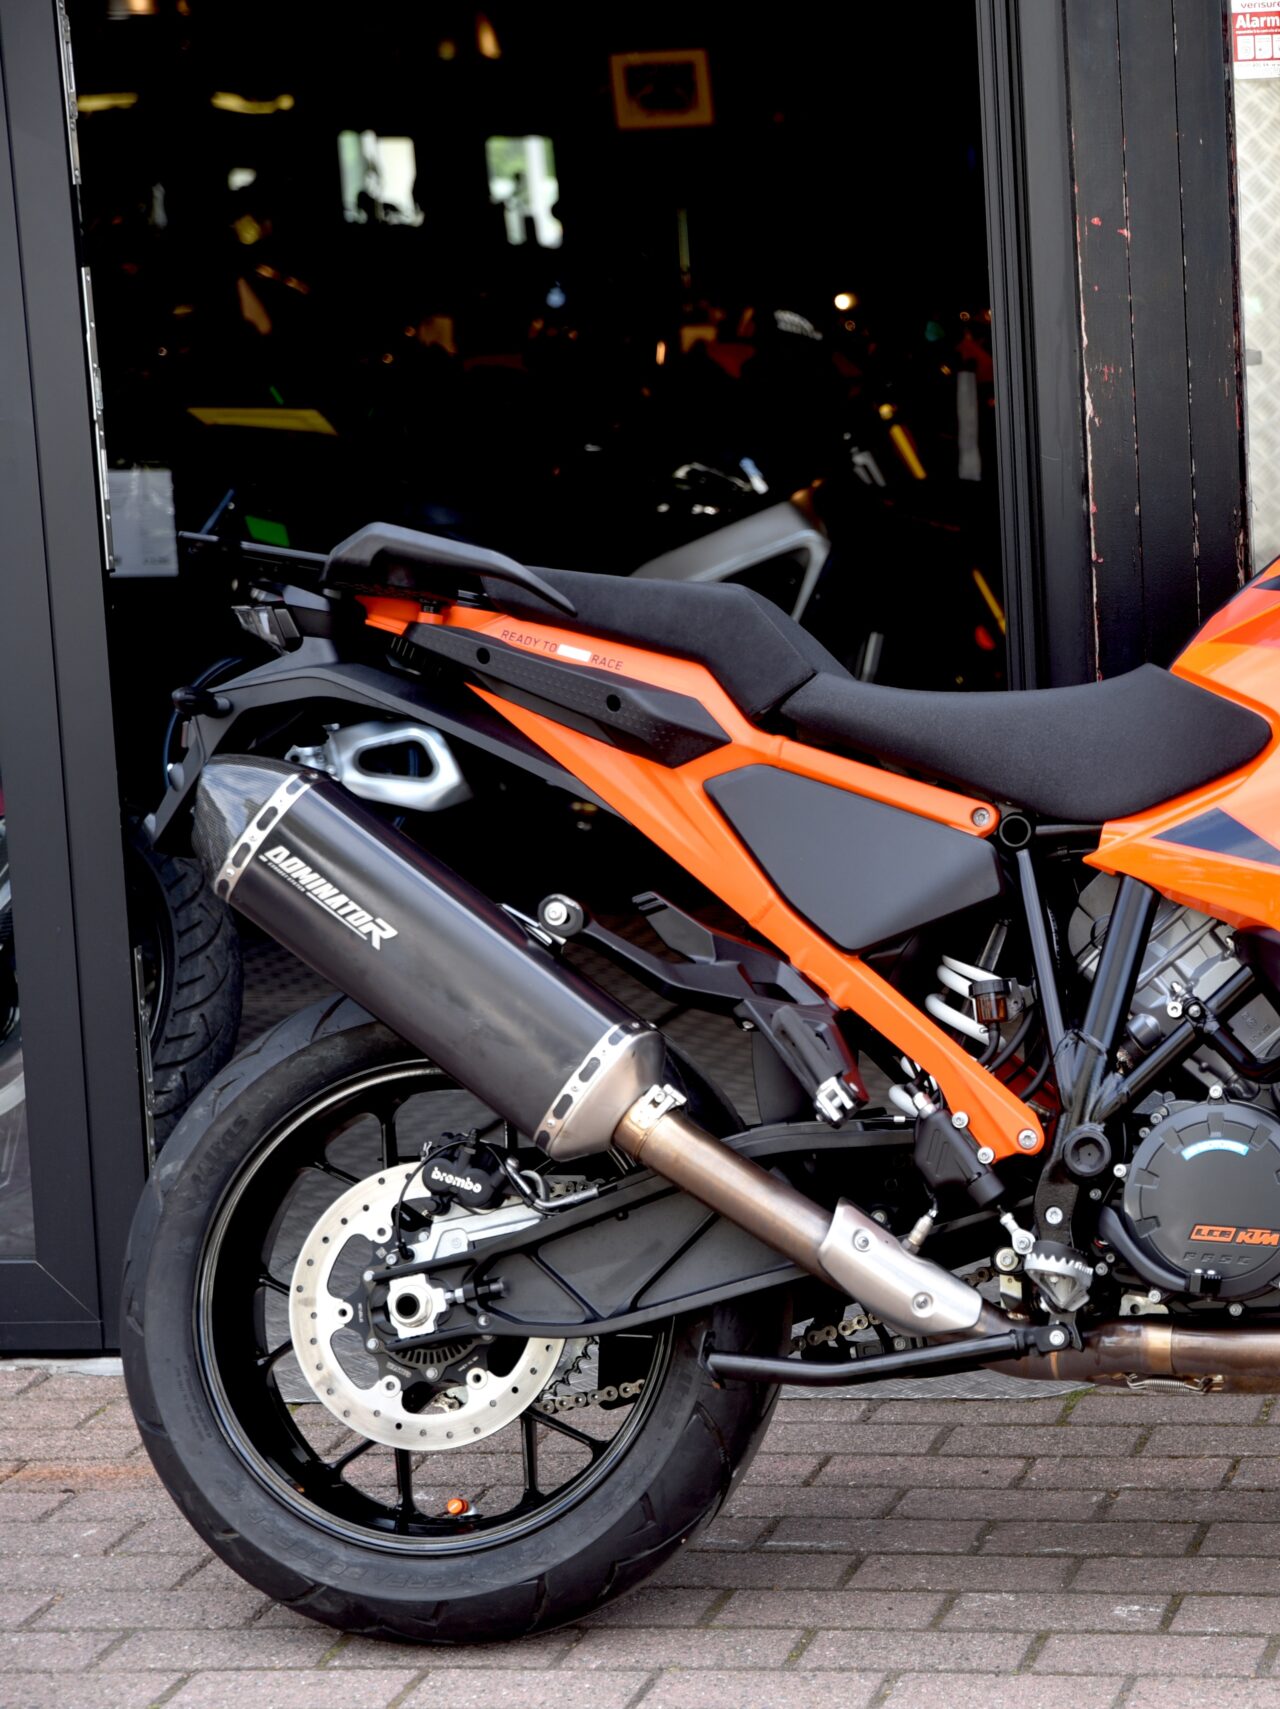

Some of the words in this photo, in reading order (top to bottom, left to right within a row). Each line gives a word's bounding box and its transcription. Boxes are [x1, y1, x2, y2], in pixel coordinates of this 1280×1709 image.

[501, 629, 541, 647] READY
[542, 640, 558, 653] TO
[590, 654, 624, 671] RACE
[263, 845, 399, 951] DOMINATOR
[430, 1166, 482, 1193] brembo
[1236, 1228, 1280, 1246] KTM
